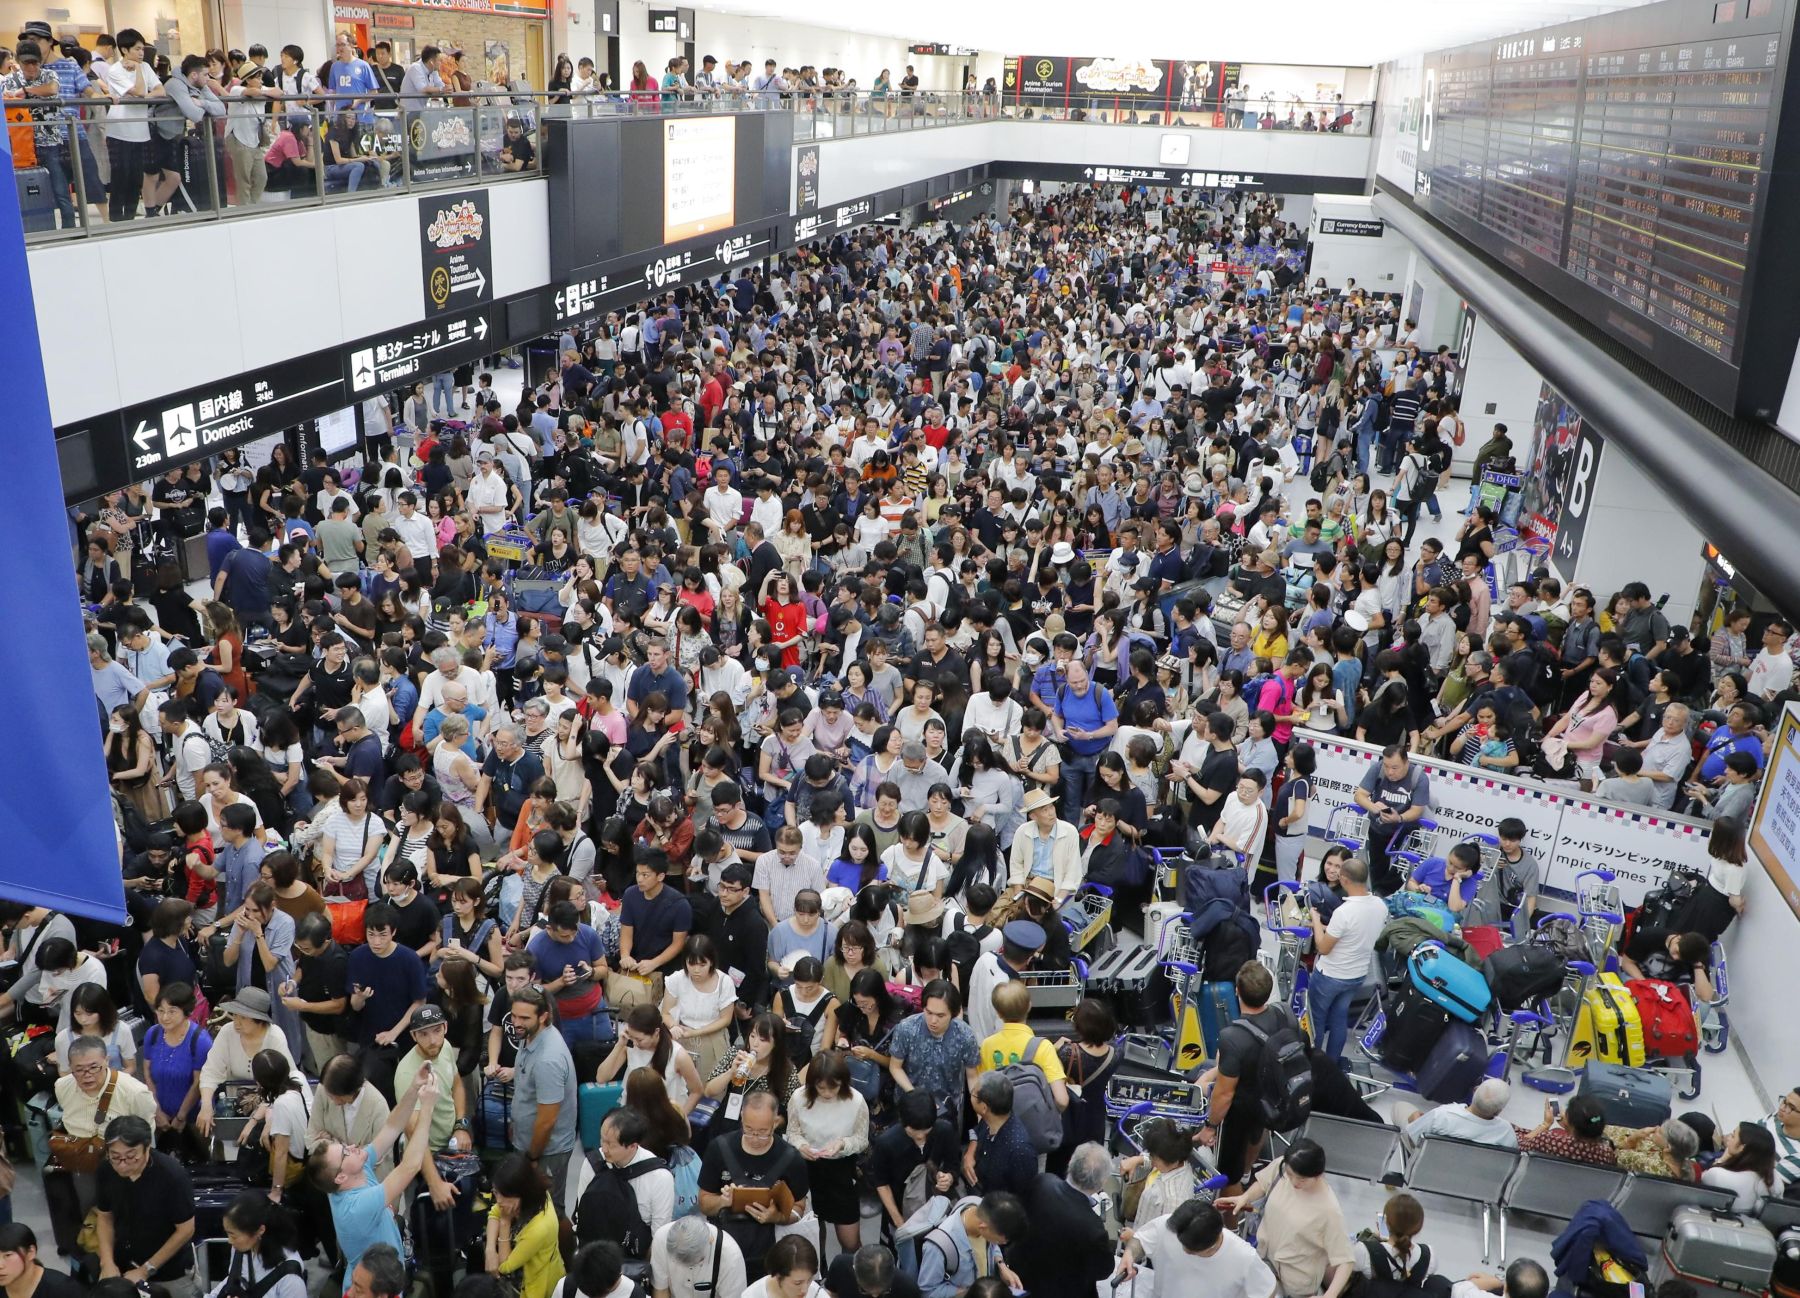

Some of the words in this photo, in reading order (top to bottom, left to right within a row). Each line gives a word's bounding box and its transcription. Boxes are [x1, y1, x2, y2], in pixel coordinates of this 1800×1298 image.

[340, 76, 351, 87] 02
[1722, 92, 1749, 105] TERMINAL
[1717, 129, 1745, 144] ARRIVING
[426, 167, 442, 175] Tourism
[1711, 167, 1739, 183] ARRIVING
[1706, 203, 1720, 217] CODE
[1722, 207, 1741, 223] SHARE
[450, 254, 465, 265] Anime
[732, 250, 750, 262] Information
[450, 263, 469, 274] Tourism
[450, 271, 477, 284] Information
[666, 272, 681, 284] Parking
[582, 300, 595, 312] Train
[1692, 308, 1705, 326] CODE
[1707, 316, 1725, 335] SHARE
[376, 329, 441, 363] 第3ターミナル
[1459, 316, 1472, 369] B
[1689, 326, 1702, 344] CODE
[1704, 334, 1722, 353] SHARE
[379, 360, 414, 383] Terminal
[413, 358, 420, 373] 3
[199, 389, 244, 421] 国内線
[202, 415, 254, 446] Domestic
[135, 451, 162, 469] 230m
[1496, 475, 1518, 485] DHC
[1569, 437, 1594, 518] B
[1560, 530, 1569, 555] A
[1311, 793, 1321, 803] A
[1381, 789, 1408, 804] PUMA
[1556, 853, 1593, 871] mpic
[1597, 862, 1647, 884] Games
[1365, 1018, 1383, 1045] DHC
